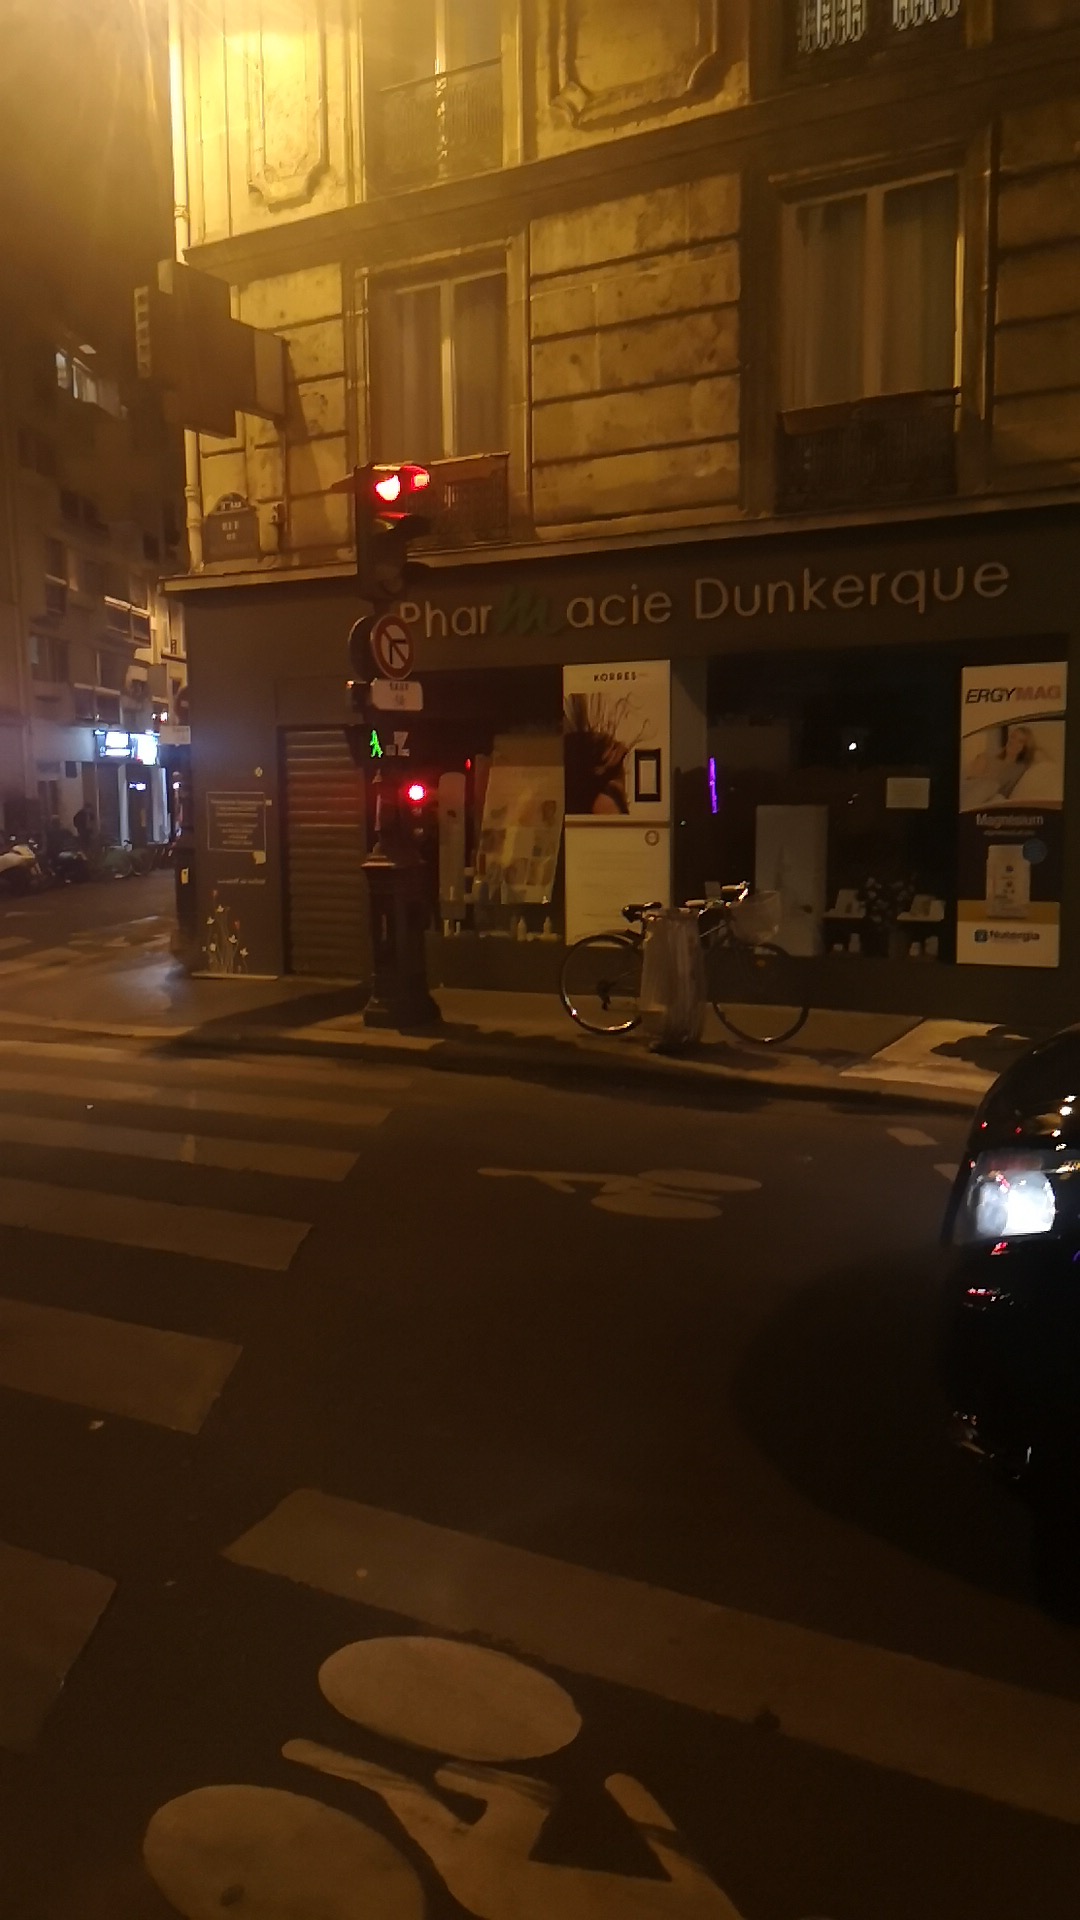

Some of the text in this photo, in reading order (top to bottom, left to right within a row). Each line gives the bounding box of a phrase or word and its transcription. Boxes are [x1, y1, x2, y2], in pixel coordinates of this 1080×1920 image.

[694, 561, 1010, 620] Dunkerque
[594, 671, 637, 682] KORRES
[965, 685, 1061, 704] ERGYMAG
